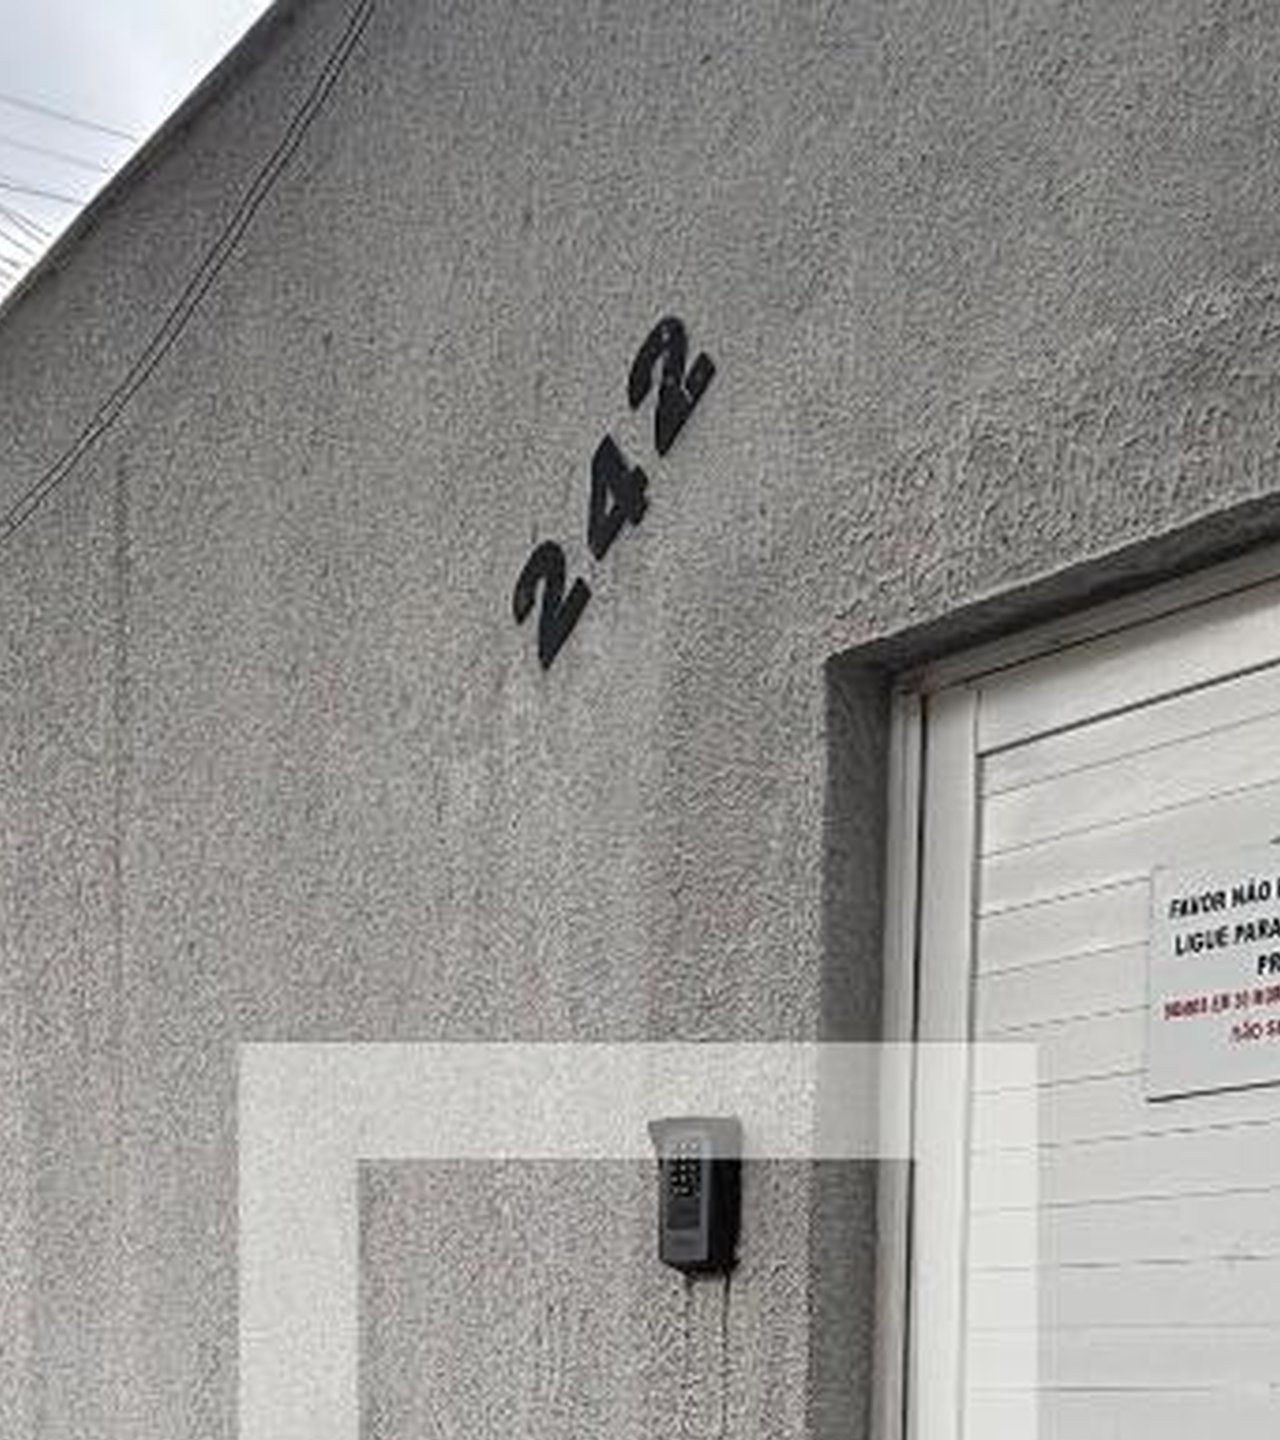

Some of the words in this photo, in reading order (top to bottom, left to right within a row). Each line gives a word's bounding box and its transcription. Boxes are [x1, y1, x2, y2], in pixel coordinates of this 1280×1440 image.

[513, 317, 716, 671] 242
[1169, 891, 1226, 920] FAVOR
[1232, 877, 1271, 908] NÃO
[1175, 926, 1229, 956] LIGUE
